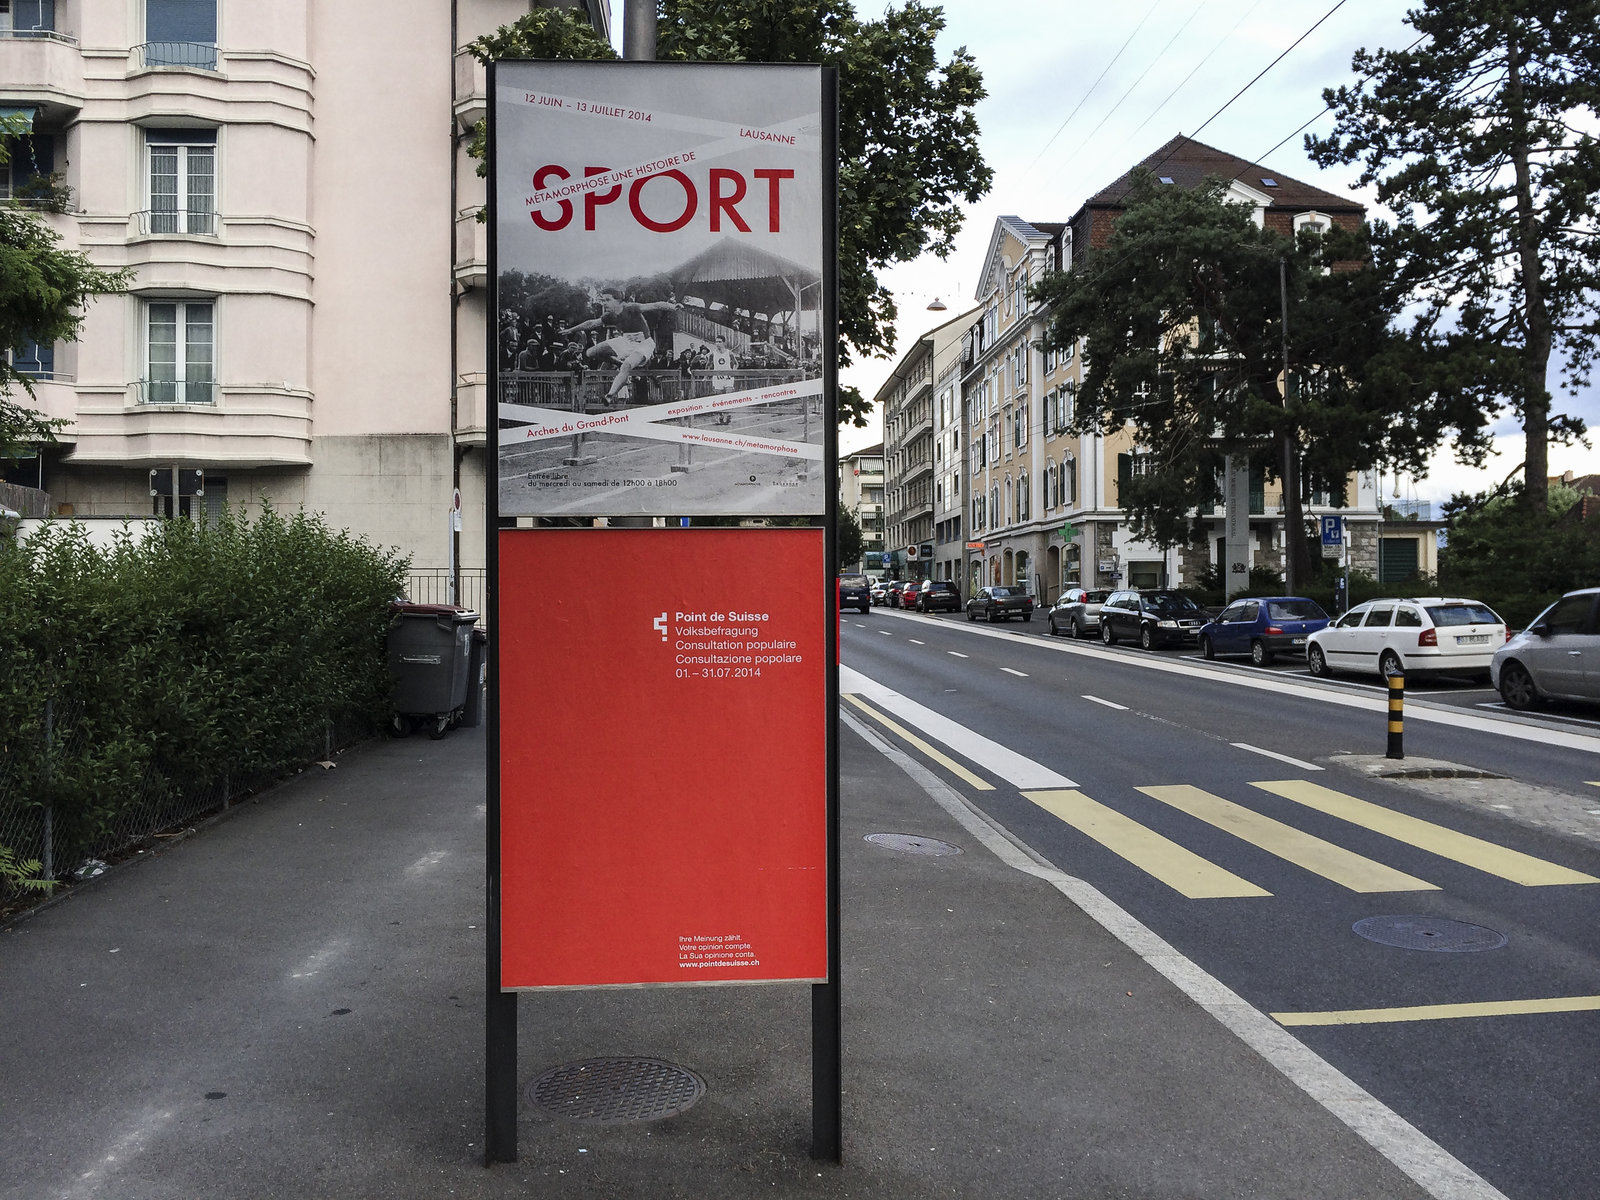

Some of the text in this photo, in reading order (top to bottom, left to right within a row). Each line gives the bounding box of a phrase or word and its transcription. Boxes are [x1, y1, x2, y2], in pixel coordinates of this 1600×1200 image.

[525, 94, 536, 103] 12
[538, 96, 562, 107] JUIN
[576, 102, 586, 111] 13
[590, 104, 625, 118] JUILLET
[628, 110, 652, 122] 2014
[739, 128, 796, 144] LAUSANNE
[526, 152, 696, 206] MÉTAMORPHOSE UNE HISTOIRE DE
[530, 164, 794, 232] SPORT
[668, 404, 703, 415] exposition
[712, 396, 752, 408] événements
[761, 389, 797, 400] rencontres
[527, 415, 629, 437] Arches du Grand-Pont
[682, 433, 798, 453] www.lausanne.ch/metamorphose
[1326, 518, 1335, 533] P
[675, 611, 769, 622] Point de Suisse
[675, 626, 759, 637] Volksbefragung
[675, 640, 796, 651] Consultation populaire
[675, 654, 802, 664] Consultazione popolare
[702, 668, 761, 678] 31.07.2014
[679, 960, 760, 968] www.pointdesuisse.ch
